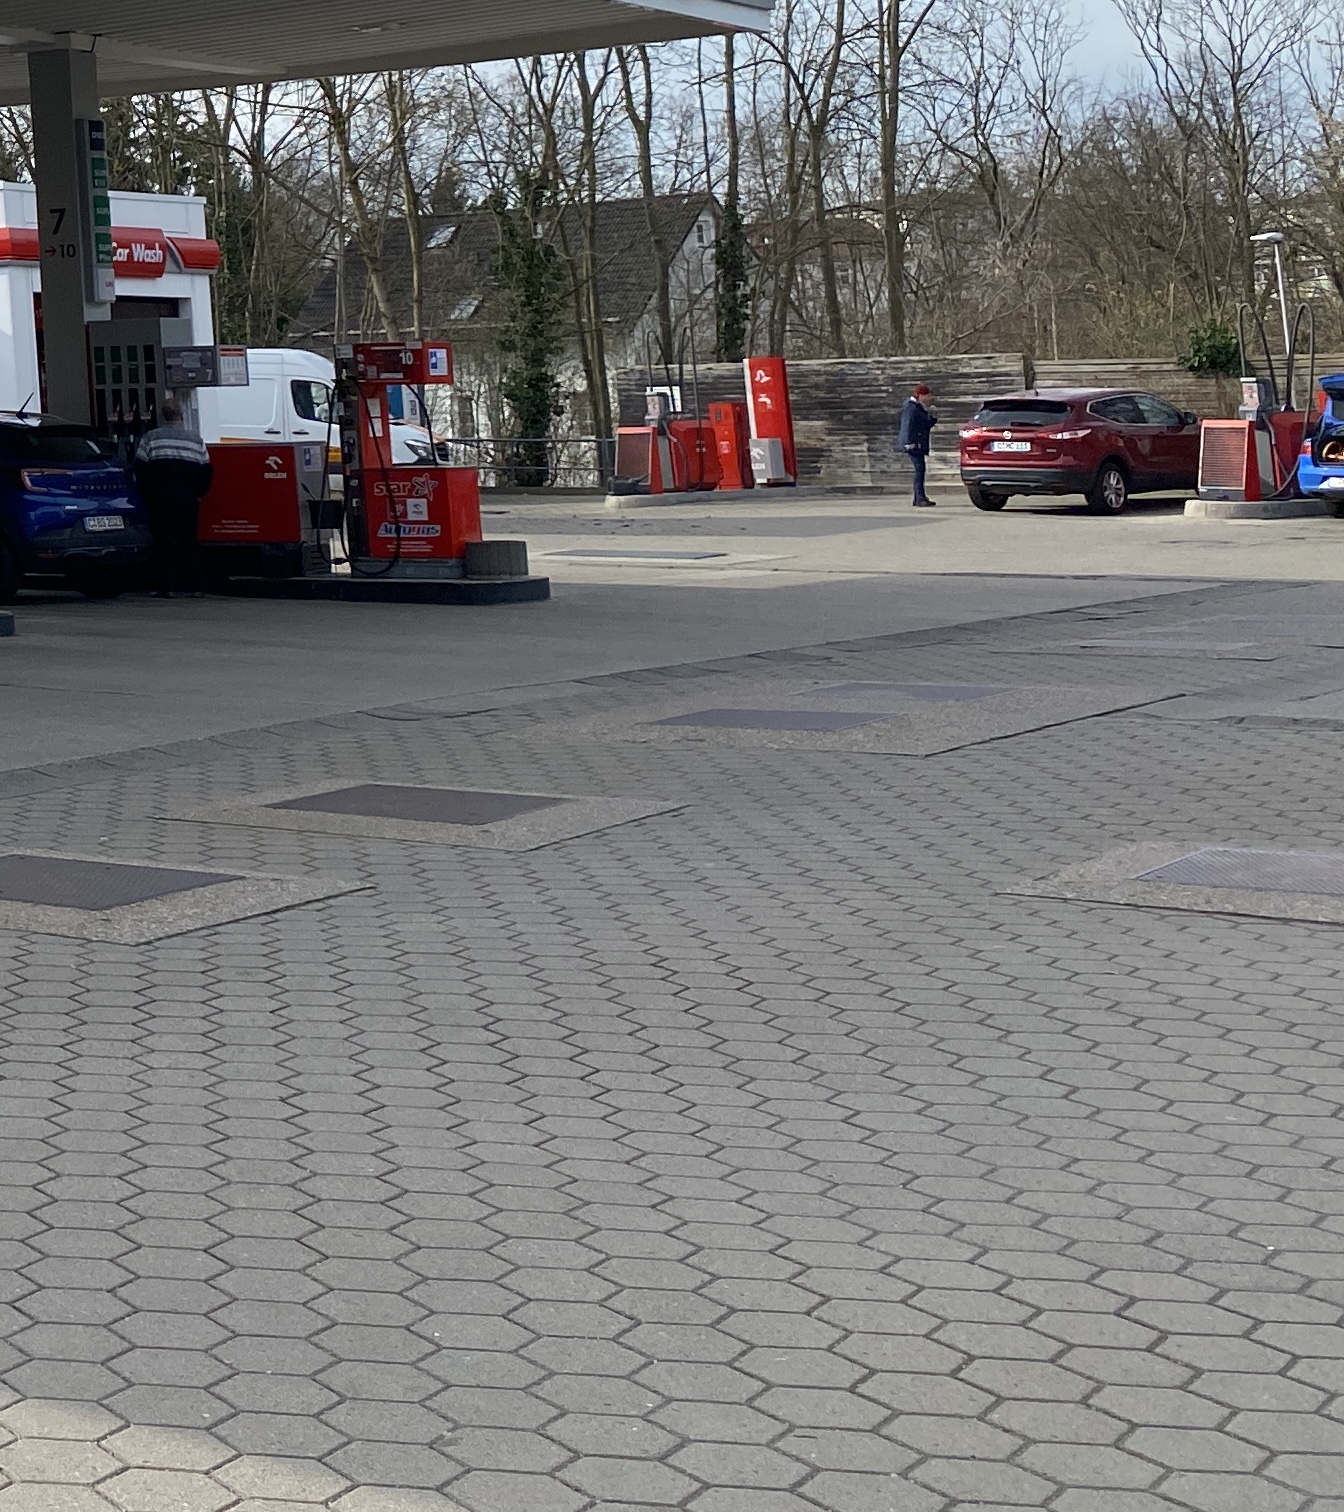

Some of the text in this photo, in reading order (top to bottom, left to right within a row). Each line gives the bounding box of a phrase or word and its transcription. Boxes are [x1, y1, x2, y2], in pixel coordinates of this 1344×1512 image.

[49, 207, 67, 235] 7
[59, 244, 77, 258] 10
[131, 241, 164, 263] Wash
[399, 351, 414, 366] 10
